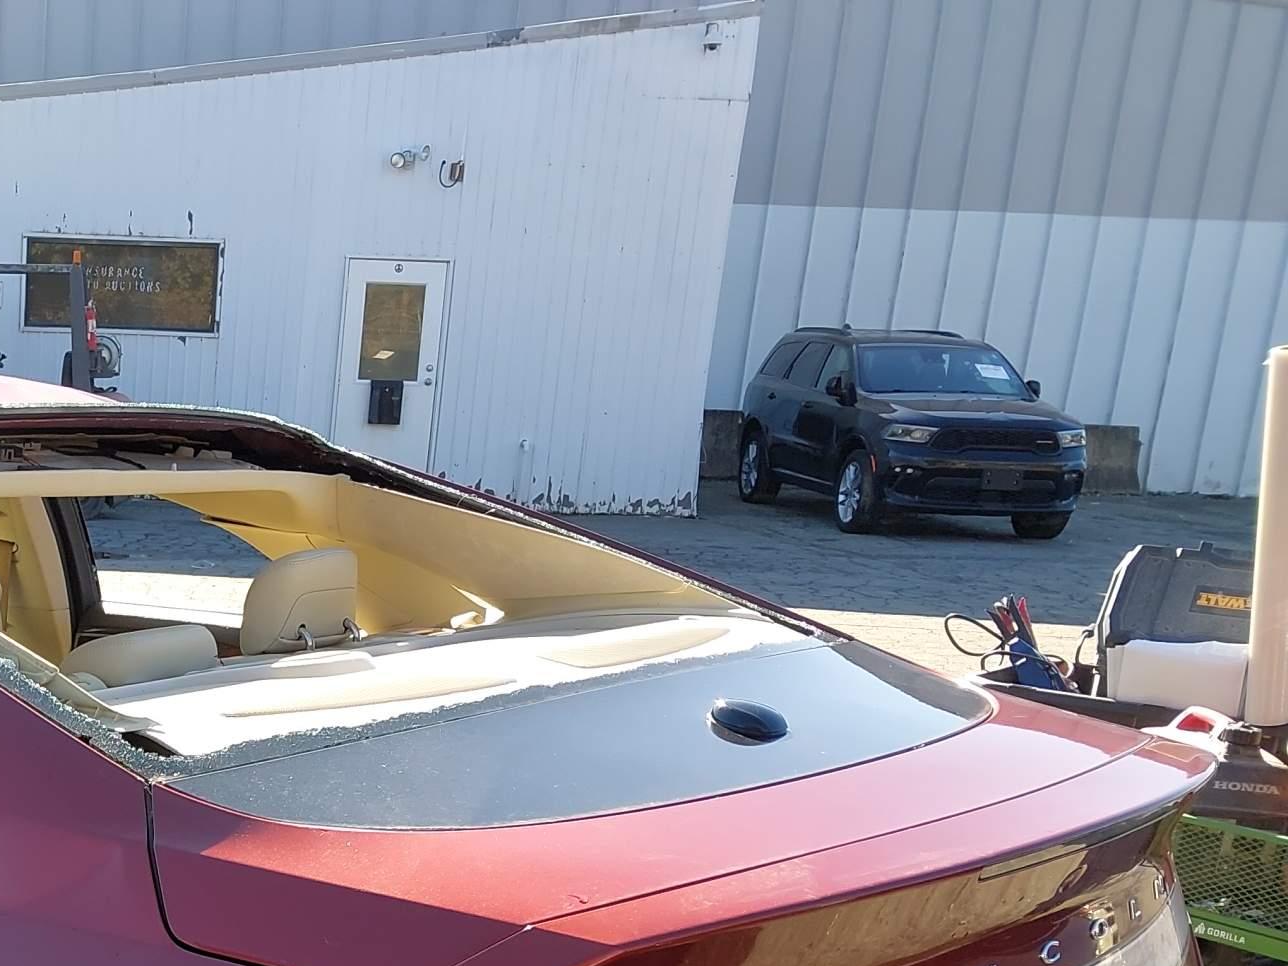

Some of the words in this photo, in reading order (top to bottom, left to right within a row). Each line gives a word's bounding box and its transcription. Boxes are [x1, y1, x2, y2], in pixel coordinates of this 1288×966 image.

[86, 265, 145, 279] NSURANCE
[1213, 780, 1280, 796] HONDA
[1206, 927, 1246, 945] GORILLA
